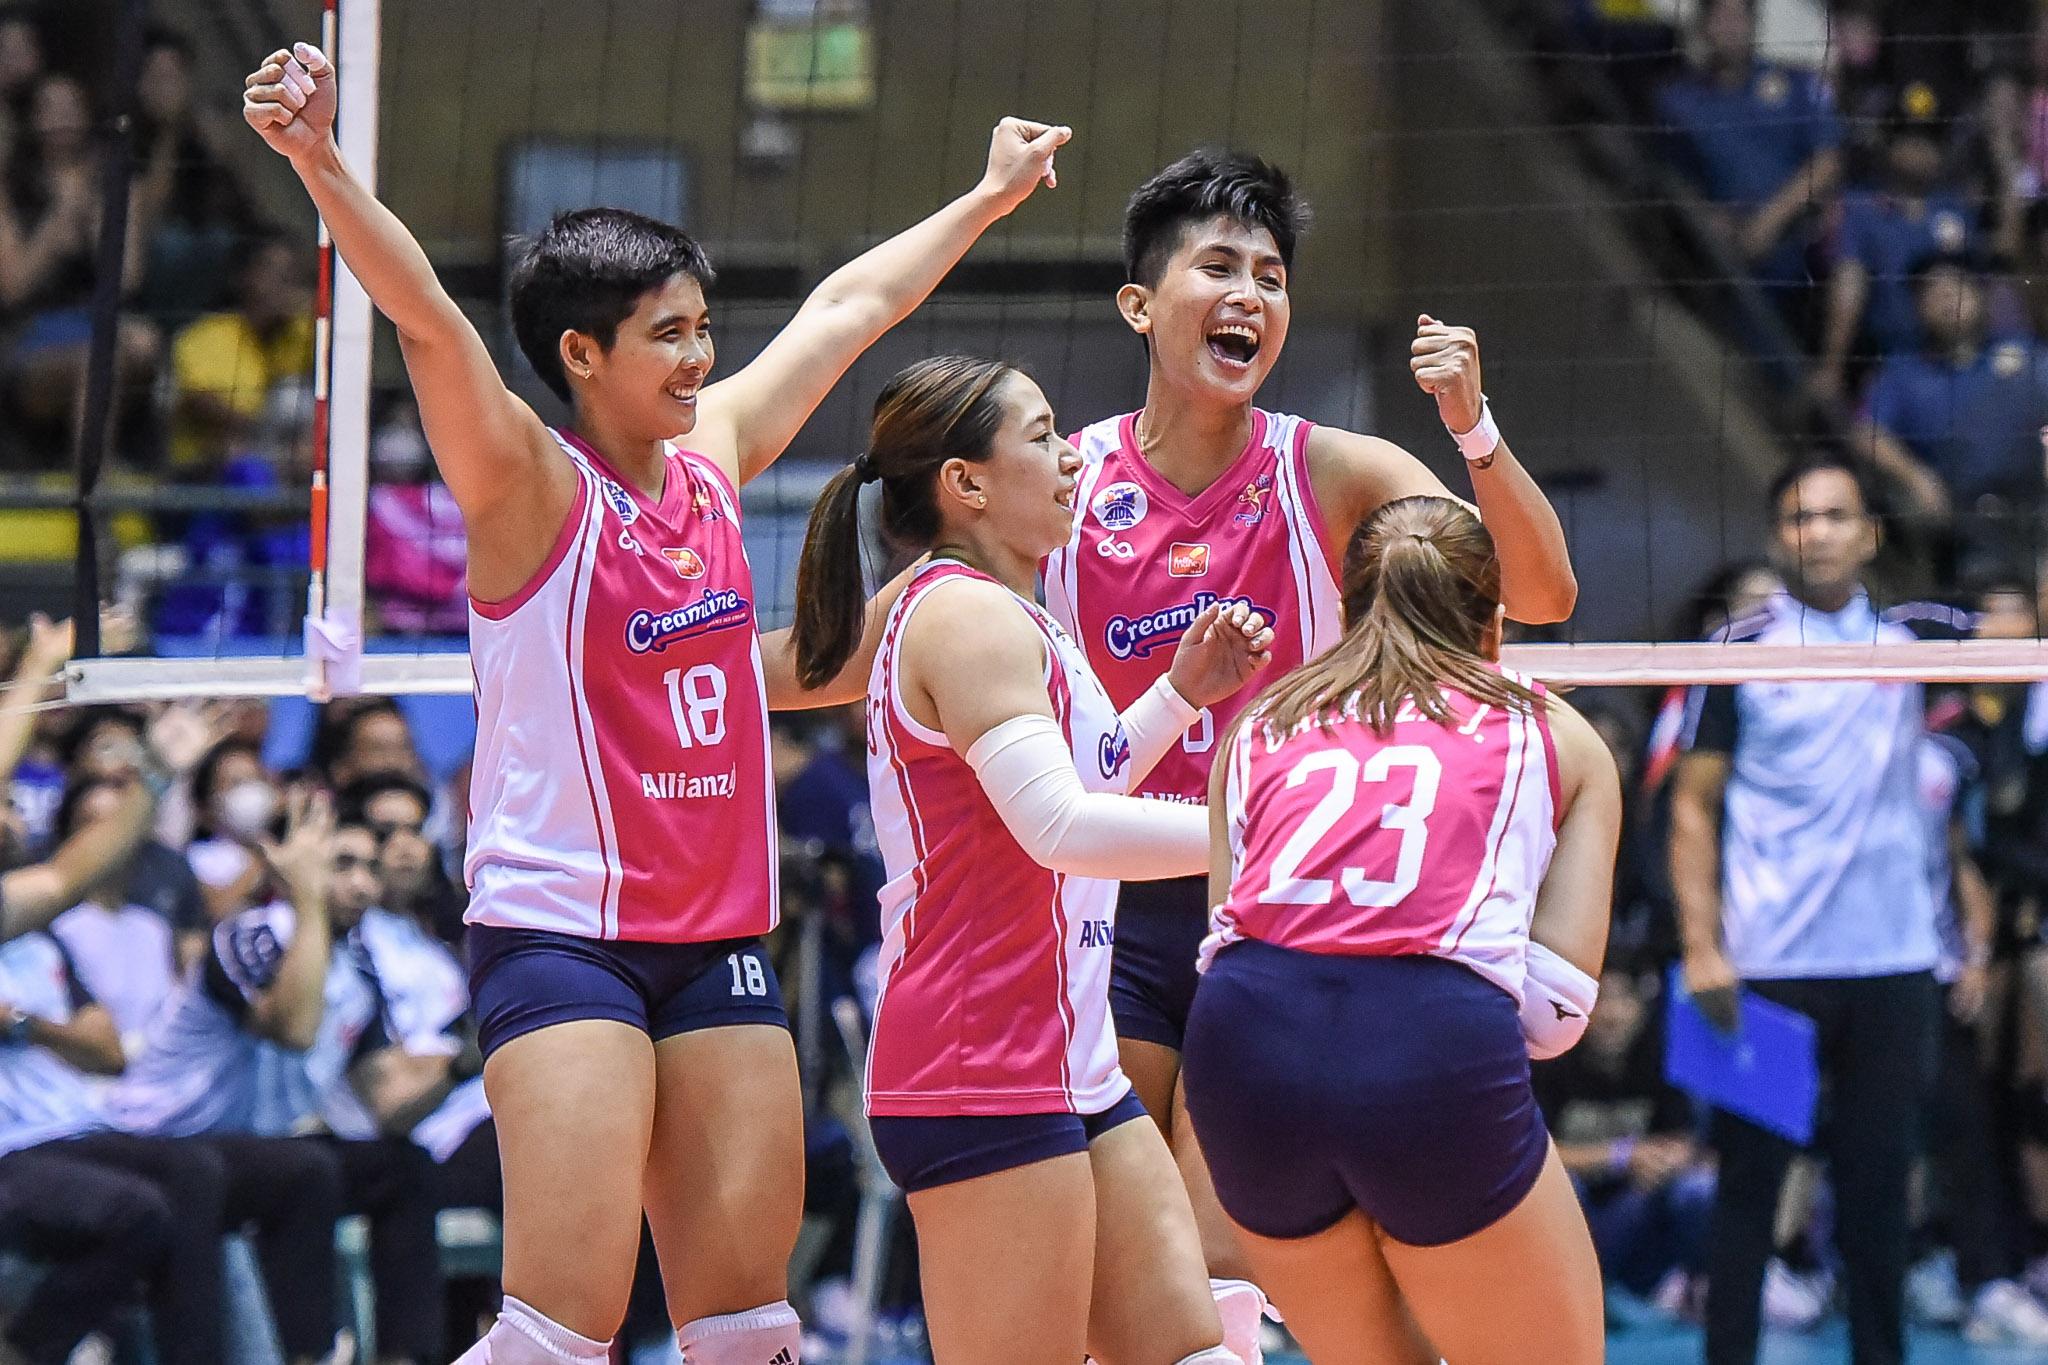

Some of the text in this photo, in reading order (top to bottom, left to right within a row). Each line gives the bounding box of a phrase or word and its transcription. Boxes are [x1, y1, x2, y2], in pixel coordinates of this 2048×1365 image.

[628, 591, 738, 652] Creamline
[1106, 595, 1250, 658] Creaml
[662, 663, 727, 749] 18
[639, 771, 730, 799] Allianz
[1257, 745, 1442, 908] 23
[727, 953, 767, 997] 18
